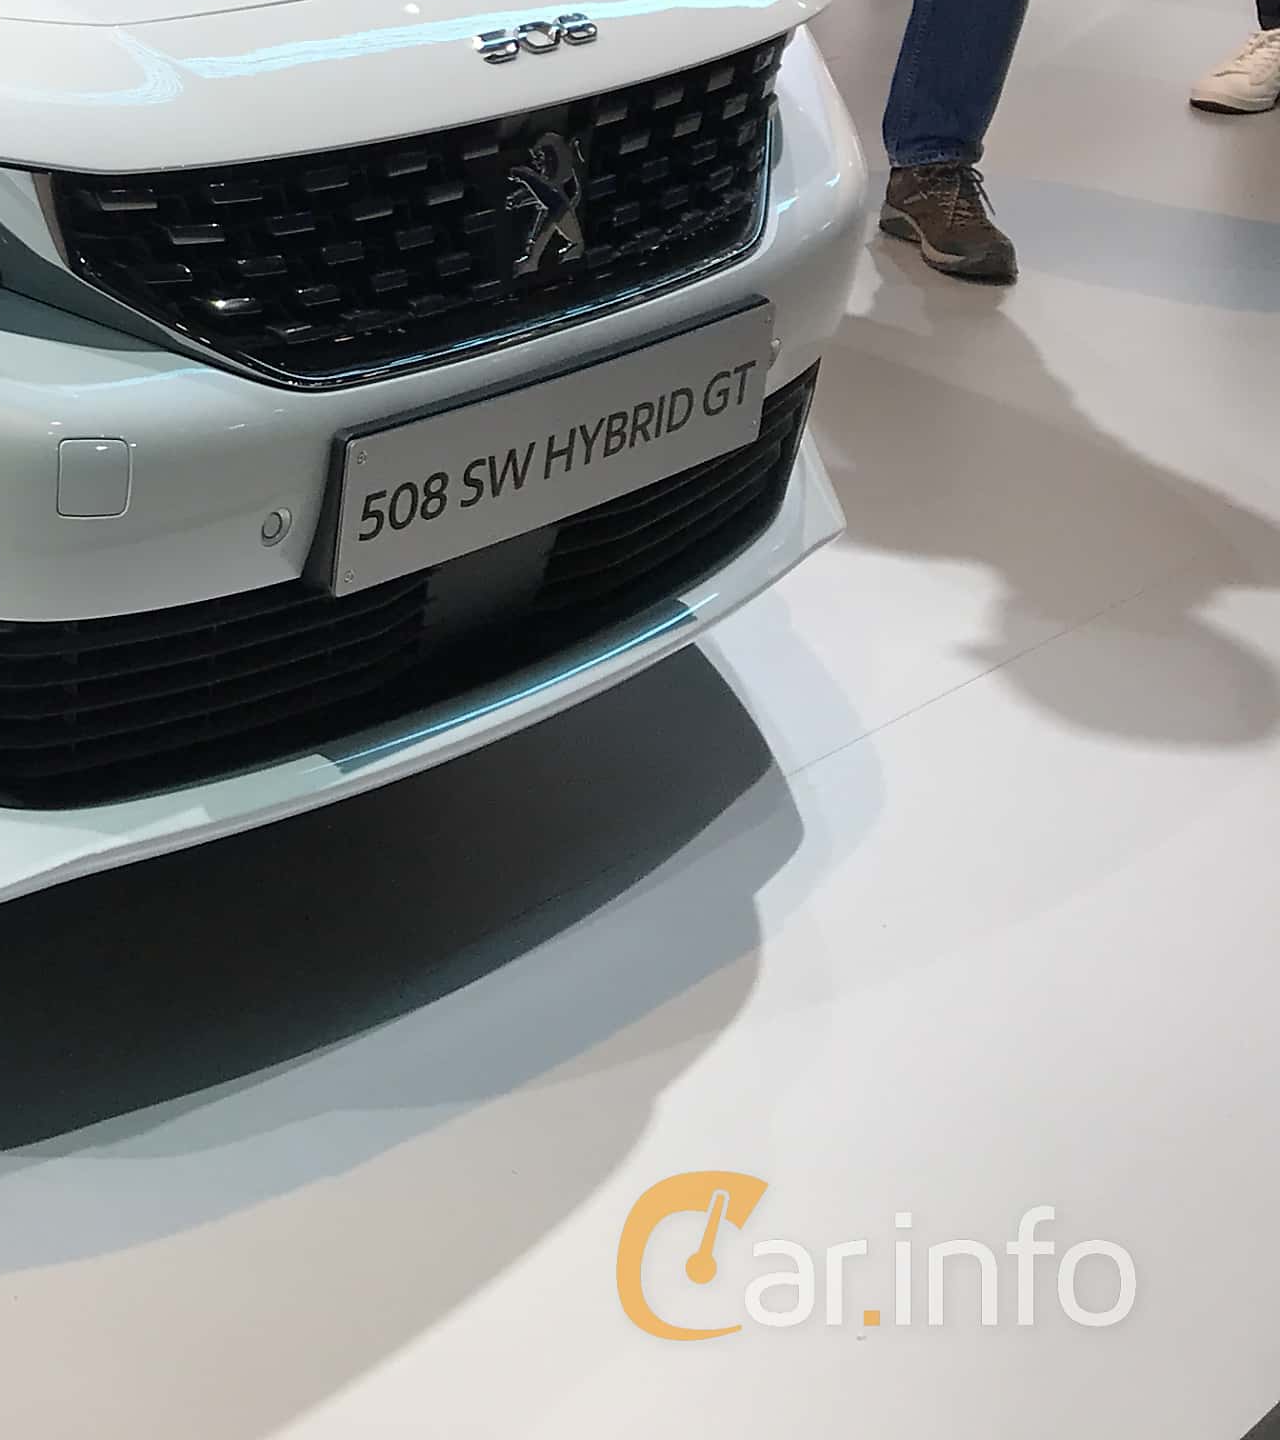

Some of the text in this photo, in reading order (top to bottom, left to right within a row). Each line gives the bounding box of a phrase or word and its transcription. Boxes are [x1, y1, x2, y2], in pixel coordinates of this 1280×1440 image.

[472, 13, 598, 64] 508
[358, 360, 757, 541] 508 SW HYBRID GT
